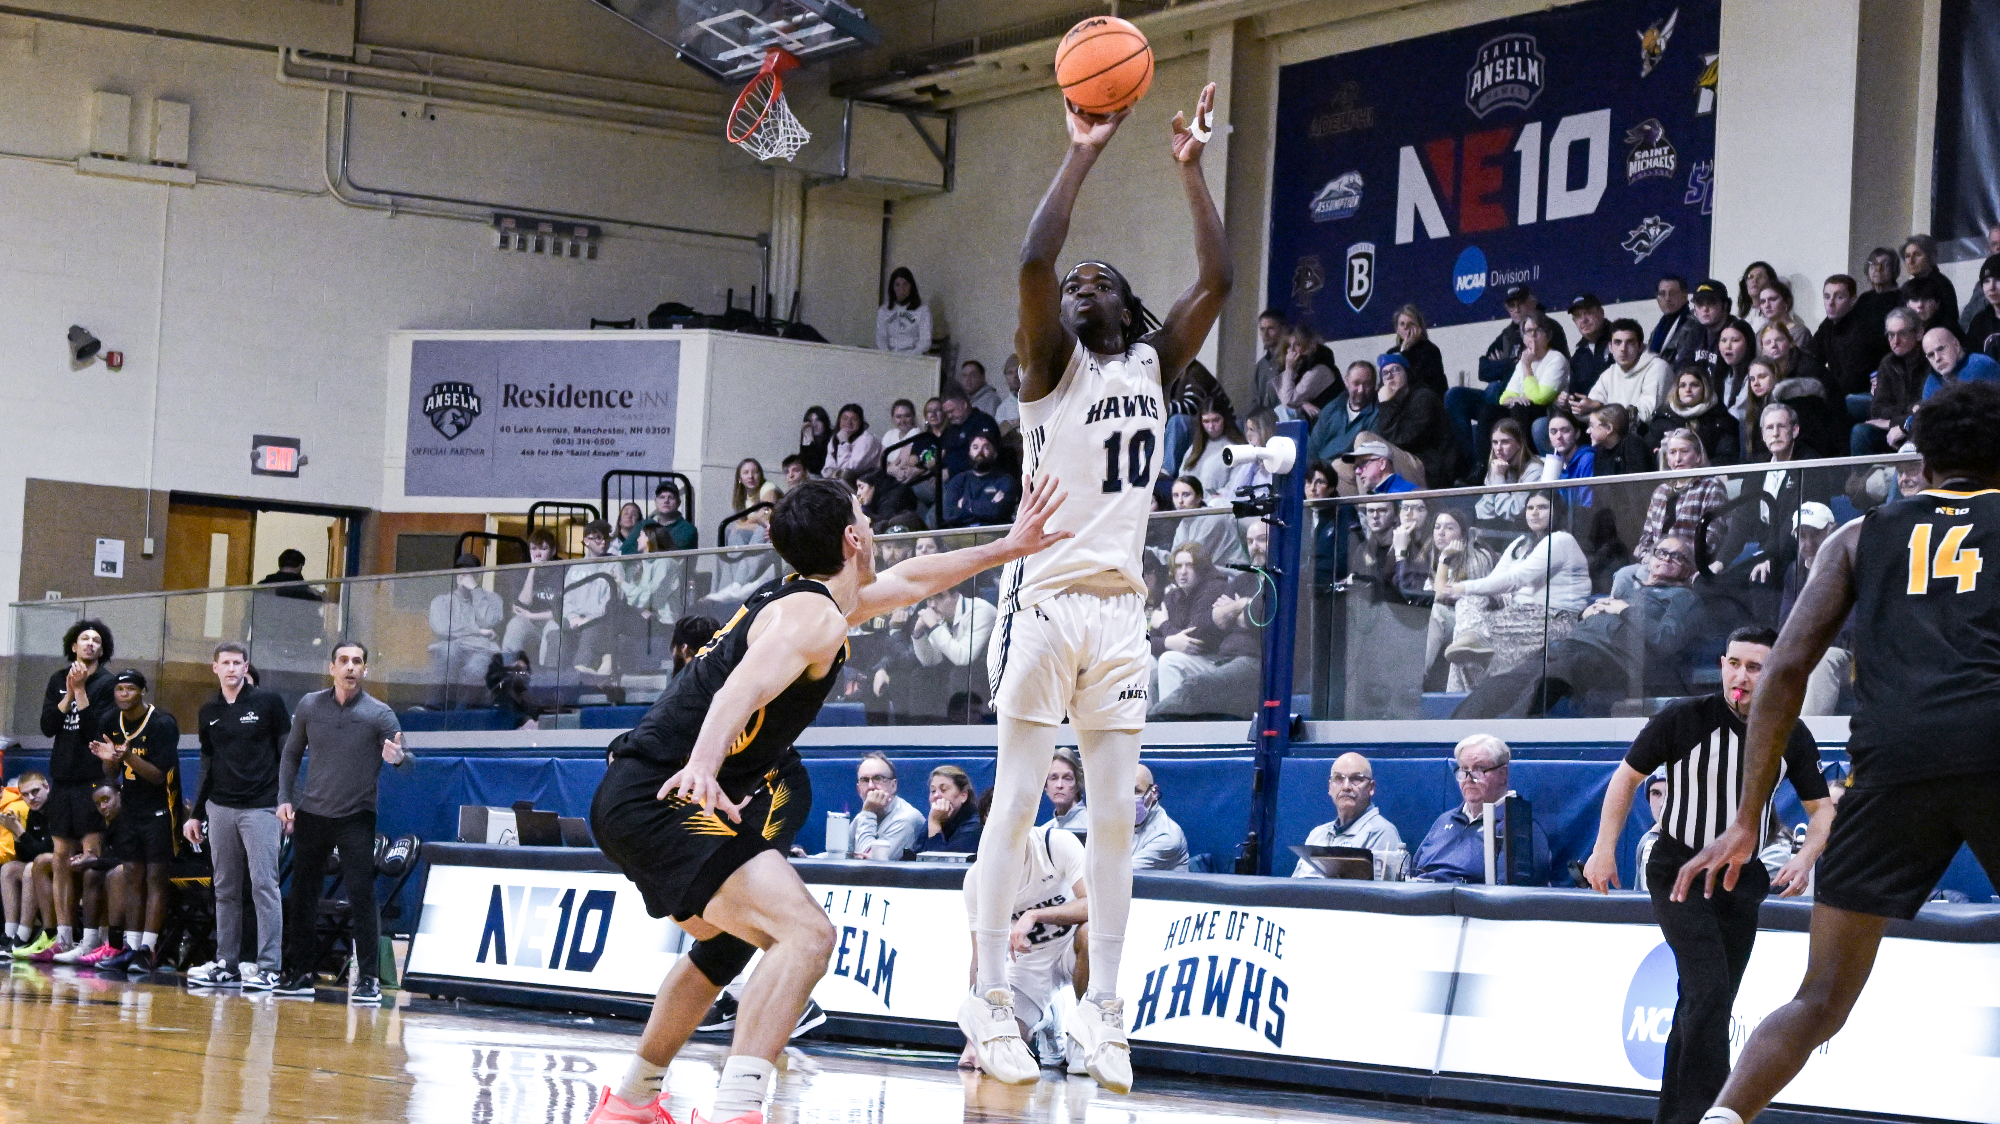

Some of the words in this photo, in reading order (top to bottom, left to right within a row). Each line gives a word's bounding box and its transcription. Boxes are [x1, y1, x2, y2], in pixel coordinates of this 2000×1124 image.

[1482, 41, 1530, 63] SAINT
[1470, 57, 1540, 99] ANSELM
[1629, 154, 1675, 177] MICHAELS
[1634, 146, 1670, 161] SAINT
[1395, 108, 1610, 244] NE10
[1350, 258, 1370, 297] B
[1456, 272, 1486, 291] NCAA
[1491, 267, 1530, 287] Division
[1533, 264, 1540, 280] II
[425, 393, 479, 412] ANSELM
[435, 384, 470, 394] SAINT
[503, 383, 634, 408] Residence
[638, 390, 669, 407] INN
[1084, 394, 1159, 425] HAWKS
[266, 446, 295, 470] EXIT
[412, 448, 446, 456] OFFICIAL
[450, 448, 485, 456] PARTNER
[1101, 428, 1156, 494] 10
[1934, 506, 1970, 515] NE10
[1906, 523, 1983, 595] 14
[824, 890, 890, 925] AINT
[476, 884, 617, 973] NE10
[1164, 911, 1220, 951] HOME
[1226, 911, 1249, 941] OF
[1254, 916, 1285, 960] THE
[834, 926, 897, 1011] ELM
[1130, 955, 1289, 1049] HAWKS
[1627, 1006, 1674, 1043] NC
